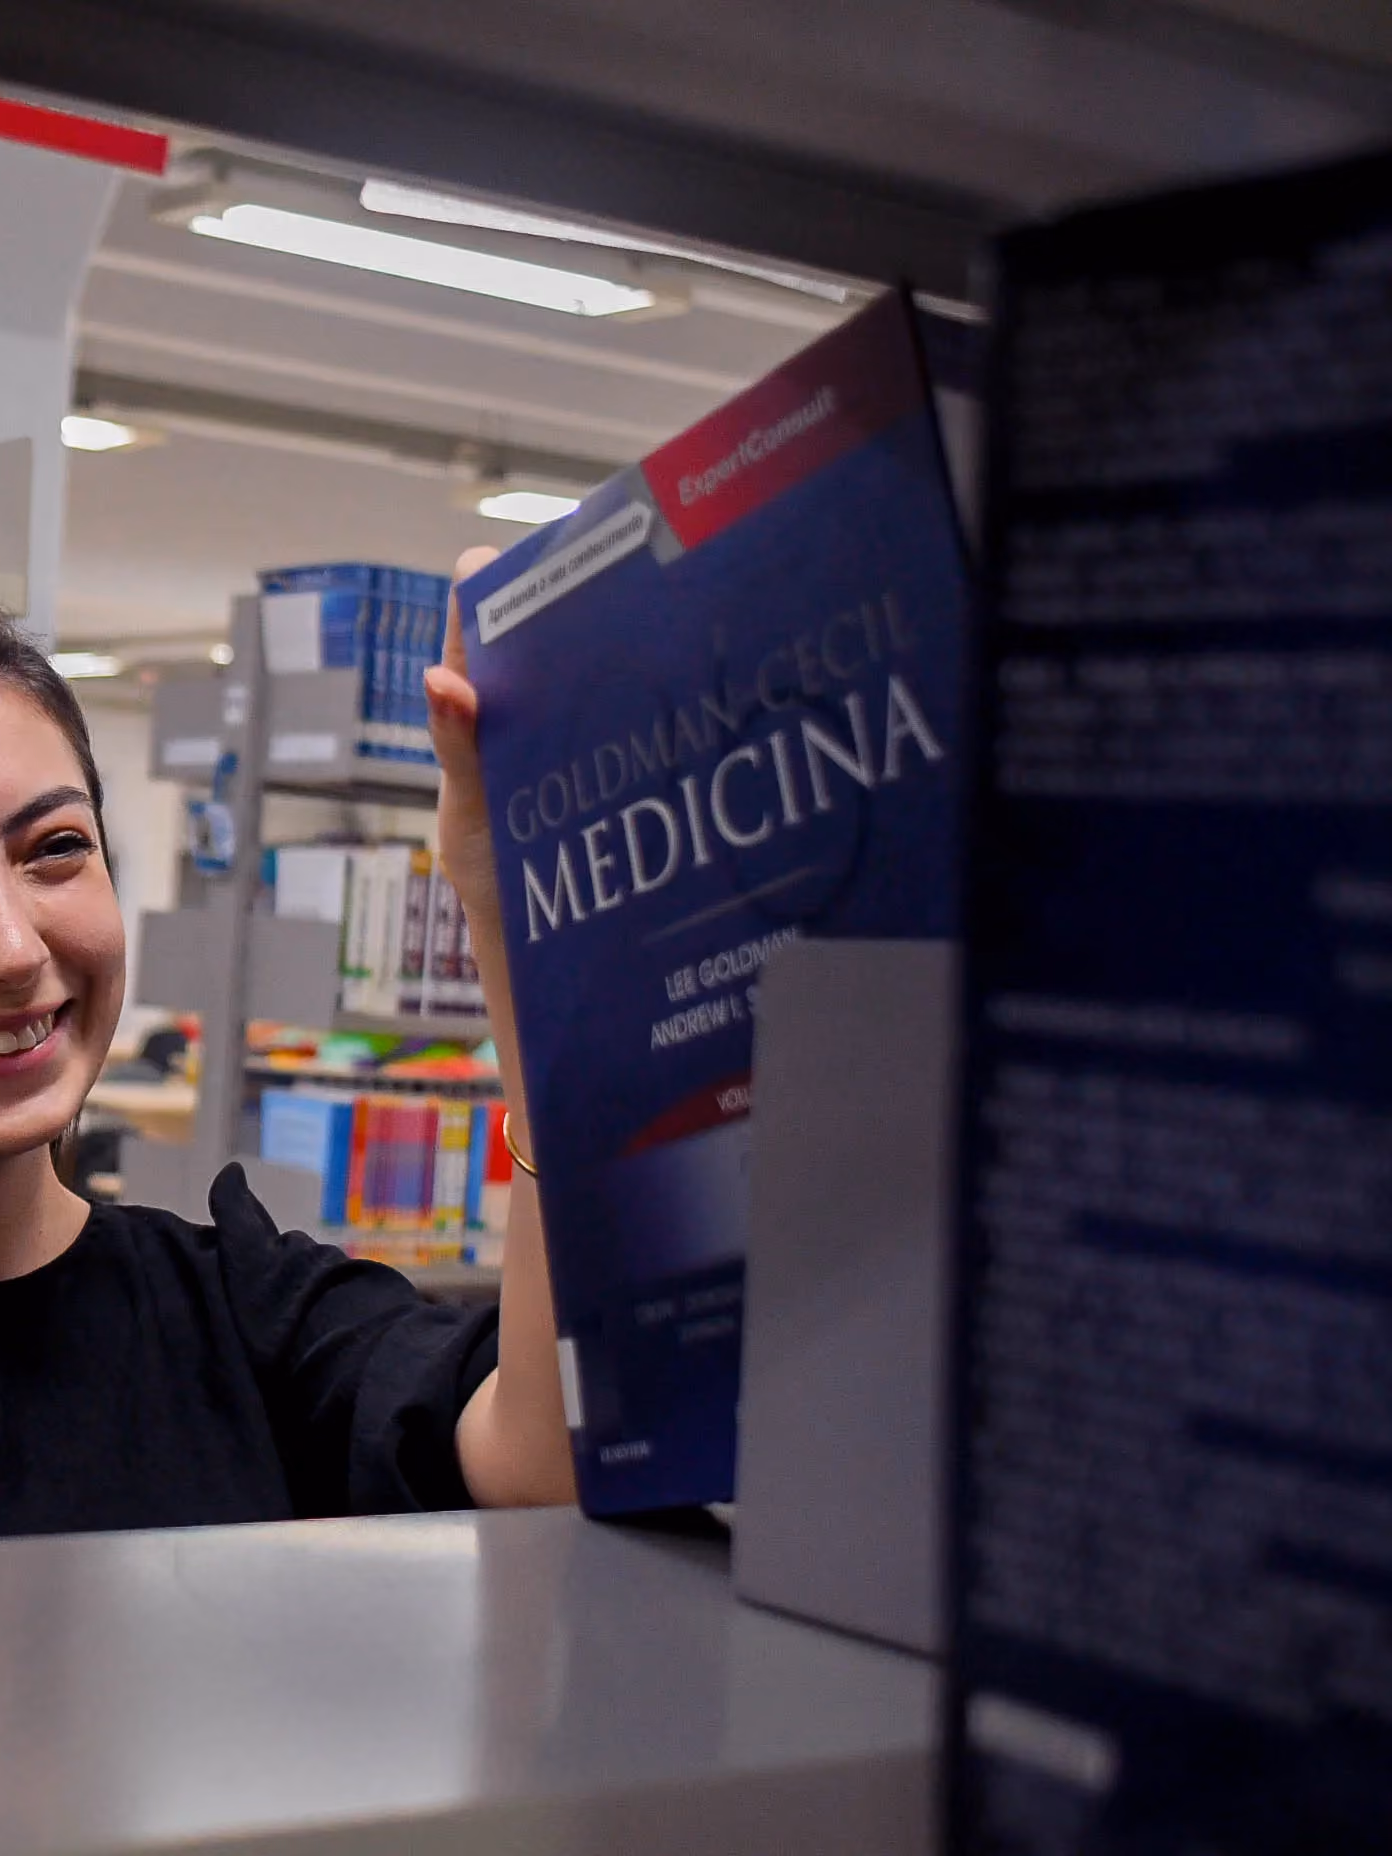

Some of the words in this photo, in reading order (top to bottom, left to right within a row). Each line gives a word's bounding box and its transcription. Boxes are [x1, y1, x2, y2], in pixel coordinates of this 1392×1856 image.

[678, 384, 835, 506] ExpertConsult
[507, 592, 914, 843] GOLDMAN-CECIL
[522, 673, 945, 943] MEDICINA
[650, 996, 730, 1050] ANDREW
[664, 964, 698, 1001] LEE
